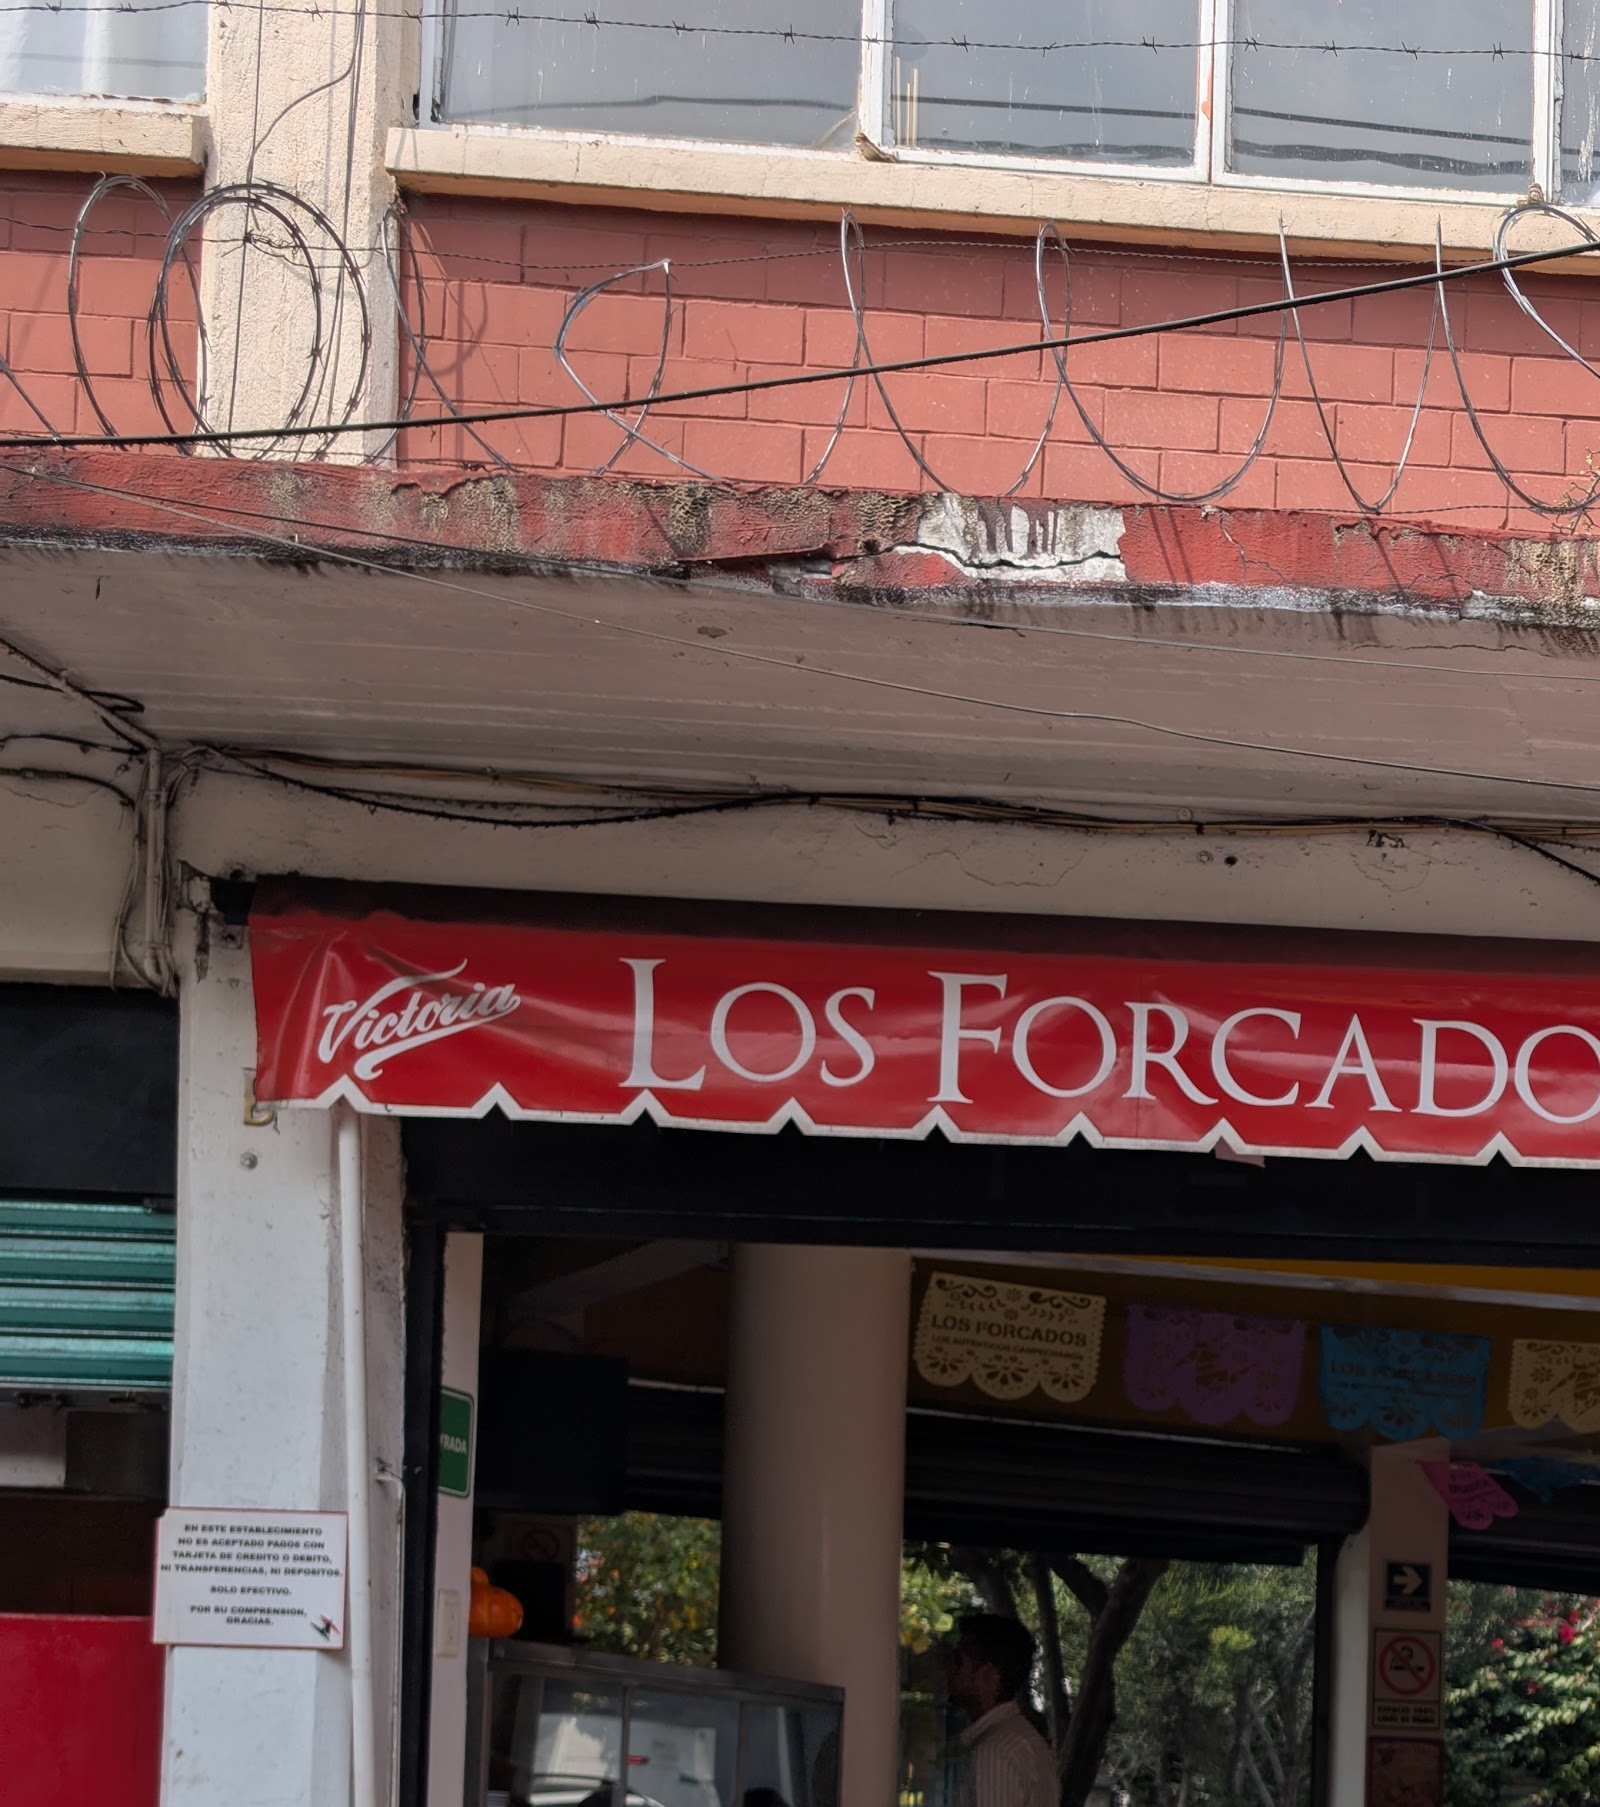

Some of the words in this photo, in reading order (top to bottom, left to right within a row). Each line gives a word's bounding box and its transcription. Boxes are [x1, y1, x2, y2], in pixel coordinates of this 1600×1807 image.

[316, 957, 522, 1081] Victoria
[618, 957, 876, 1090] LOS
[932, 1314, 970, 1332] LOS
[976, 1320, 1087, 1346] FORCADOS
[184, 1524, 197, 1532] EN
[201, 1524, 227, 1533] ESTE
[229, 1525, 323, 1536] ESTABLECIMIENTO
[178, 1537, 193, 1546] NO
[196, 1538, 209, 1546] ES
[211, 1539, 265, 1548] ACEPTADO
[267, 1540, 301, 1548] PAGOS
[303, 1540, 325, 1549] CON
[173, 1551, 217, 1560] TARJETA
[220, 1552, 233, 1560] DE
[236, 1553, 279, 1562] CREDITO
[282, 1554, 289, 1562] O
[161, 1564, 171, 1572] NI
[270, 1567, 281, 1575] NI
[210, 1585, 237, 1594] SOLO
[190, 1605, 211, 1614] POR
[214, 1606, 228, 1614] SU
